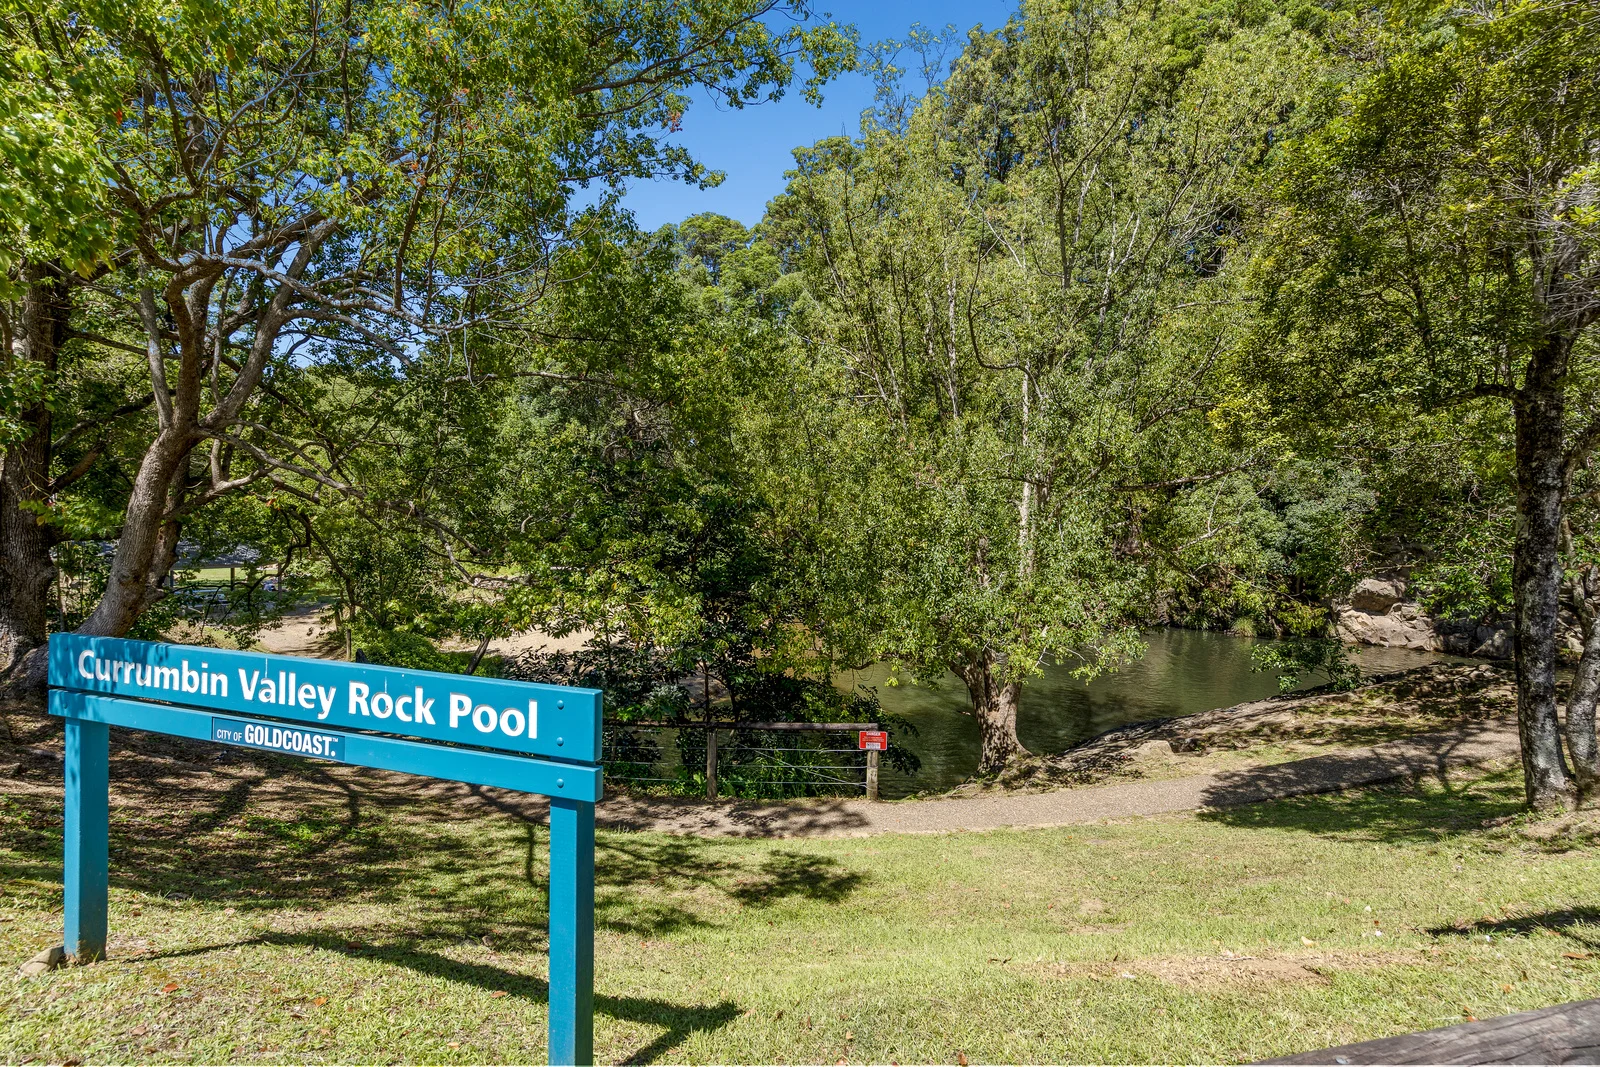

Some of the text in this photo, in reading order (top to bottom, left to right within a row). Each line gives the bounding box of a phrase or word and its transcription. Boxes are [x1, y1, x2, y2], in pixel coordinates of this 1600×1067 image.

[78, 650, 538, 739] Currumbin Valley Rock Pool
[216, 729, 232, 740] CITY
[233, 731, 243, 741] OF
